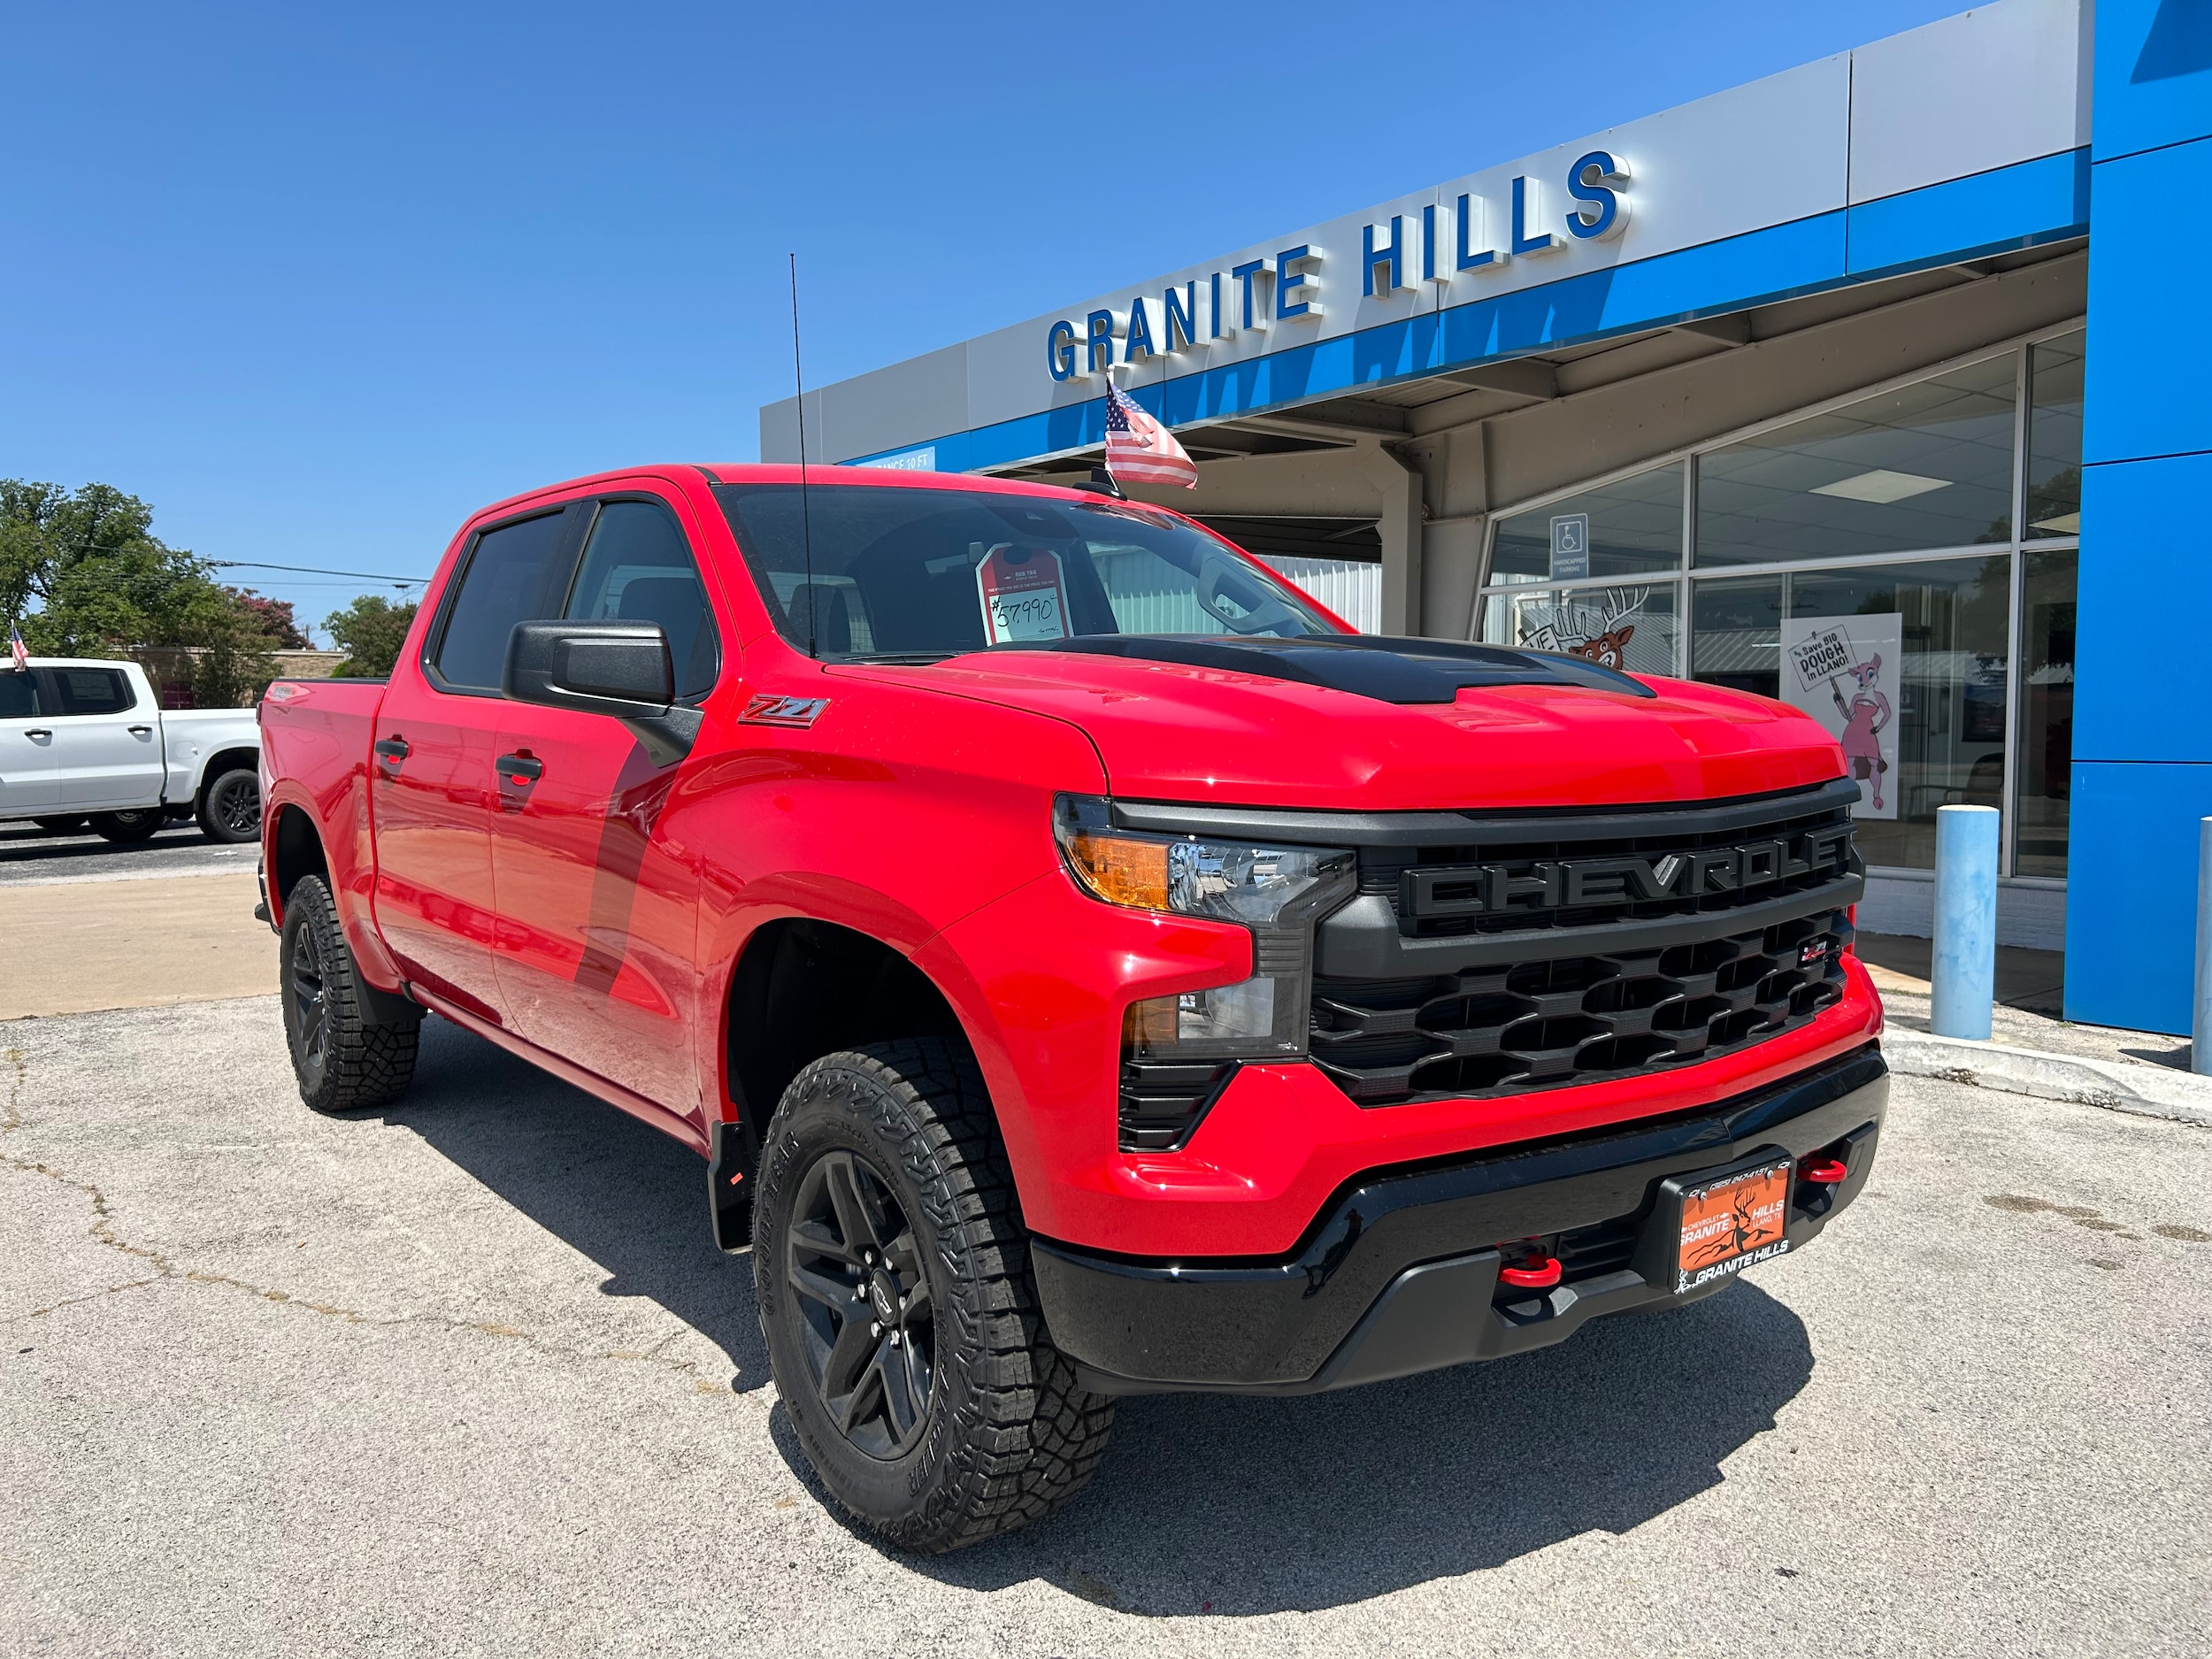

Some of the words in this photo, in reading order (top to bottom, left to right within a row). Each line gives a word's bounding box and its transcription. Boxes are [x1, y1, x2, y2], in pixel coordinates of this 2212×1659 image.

[1048, 244, 1323, 384] GRANITE
[1362, 150, 1631, 299] HILLS
[906, 457, 916, 470] 10
[918, 454, 928, 467] FT
[1800, 641, 1845, 673] DOUGH
[1802, 642, 1823, 656] Save
[1816, 655, 1849, 676] LLANO!
[737, 694, 832, 730] Z71
[1399, 823, 1857, 919] CHEVROLET
[1752, 1200, 1785, 1220] HILLS
[1774, 1212, 1782, 1221] TX
[1687, 1213, 1720, 1230] CHEVROLET
[1694, 1252, 1753, 1285] GRANITE
[1754, 1240, 1789, 1263] HILLS
